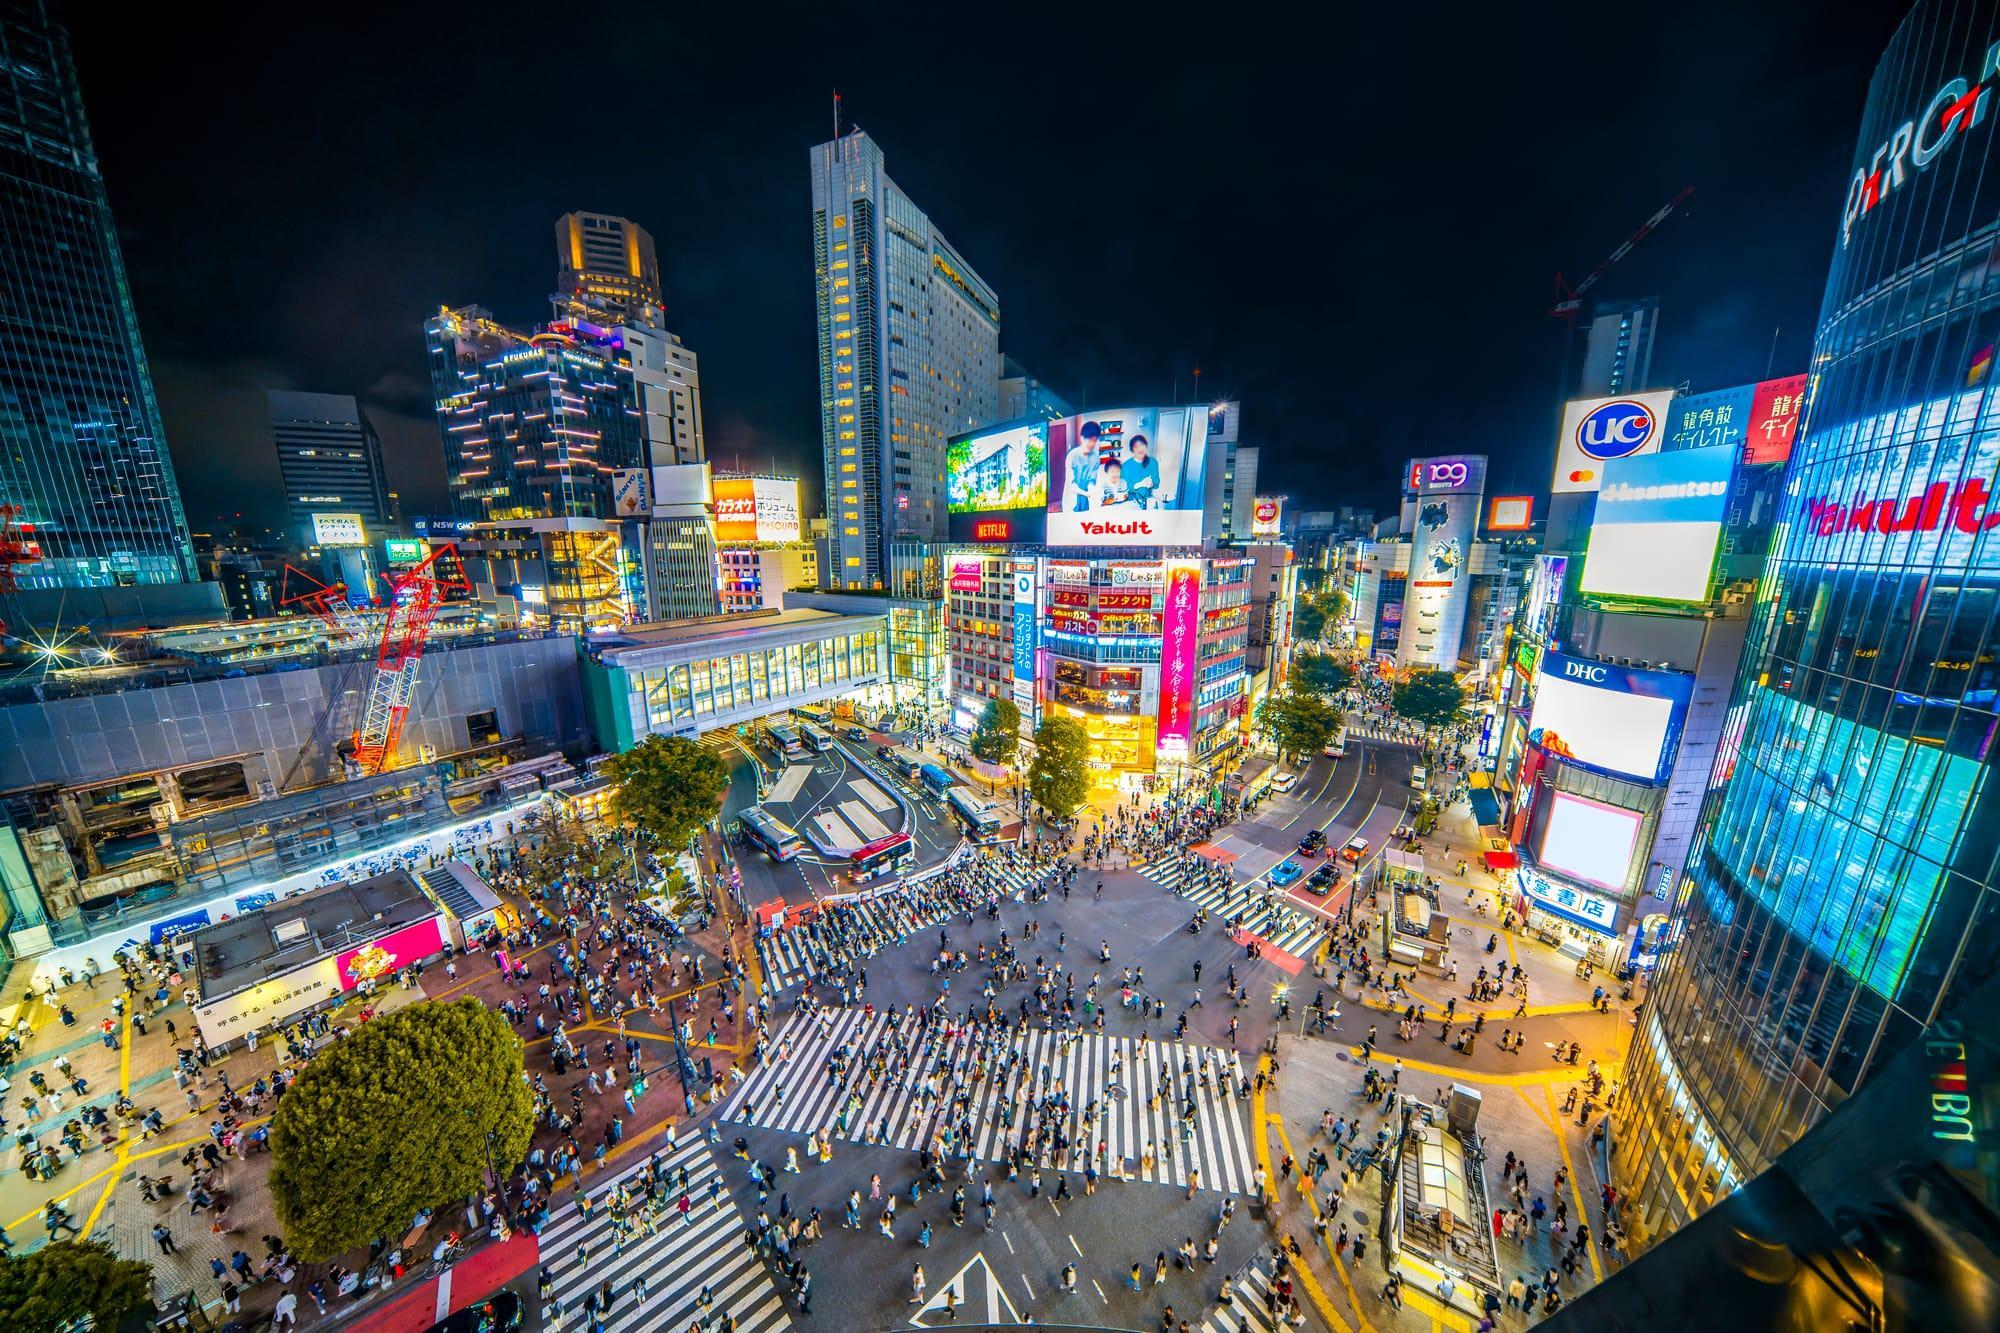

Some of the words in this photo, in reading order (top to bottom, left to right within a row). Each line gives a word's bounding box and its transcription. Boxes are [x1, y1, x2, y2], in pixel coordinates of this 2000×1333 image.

[1683, 404, 1733, 430] 龍角散
[1429, 463, 1468, 487] 109
[716, 498, 754, 512] カラオケ
[978, 523, 1008, 538] NETFLIX
[1080, 522, 1153, 535] Yakult
[1099, 595, 1150, 606] コンタクト
[1133, 613, 1158, 623] ガスト
[1064, 621, 1086, 633] ガスト
[1565, 661, 1607, 682] DHC
